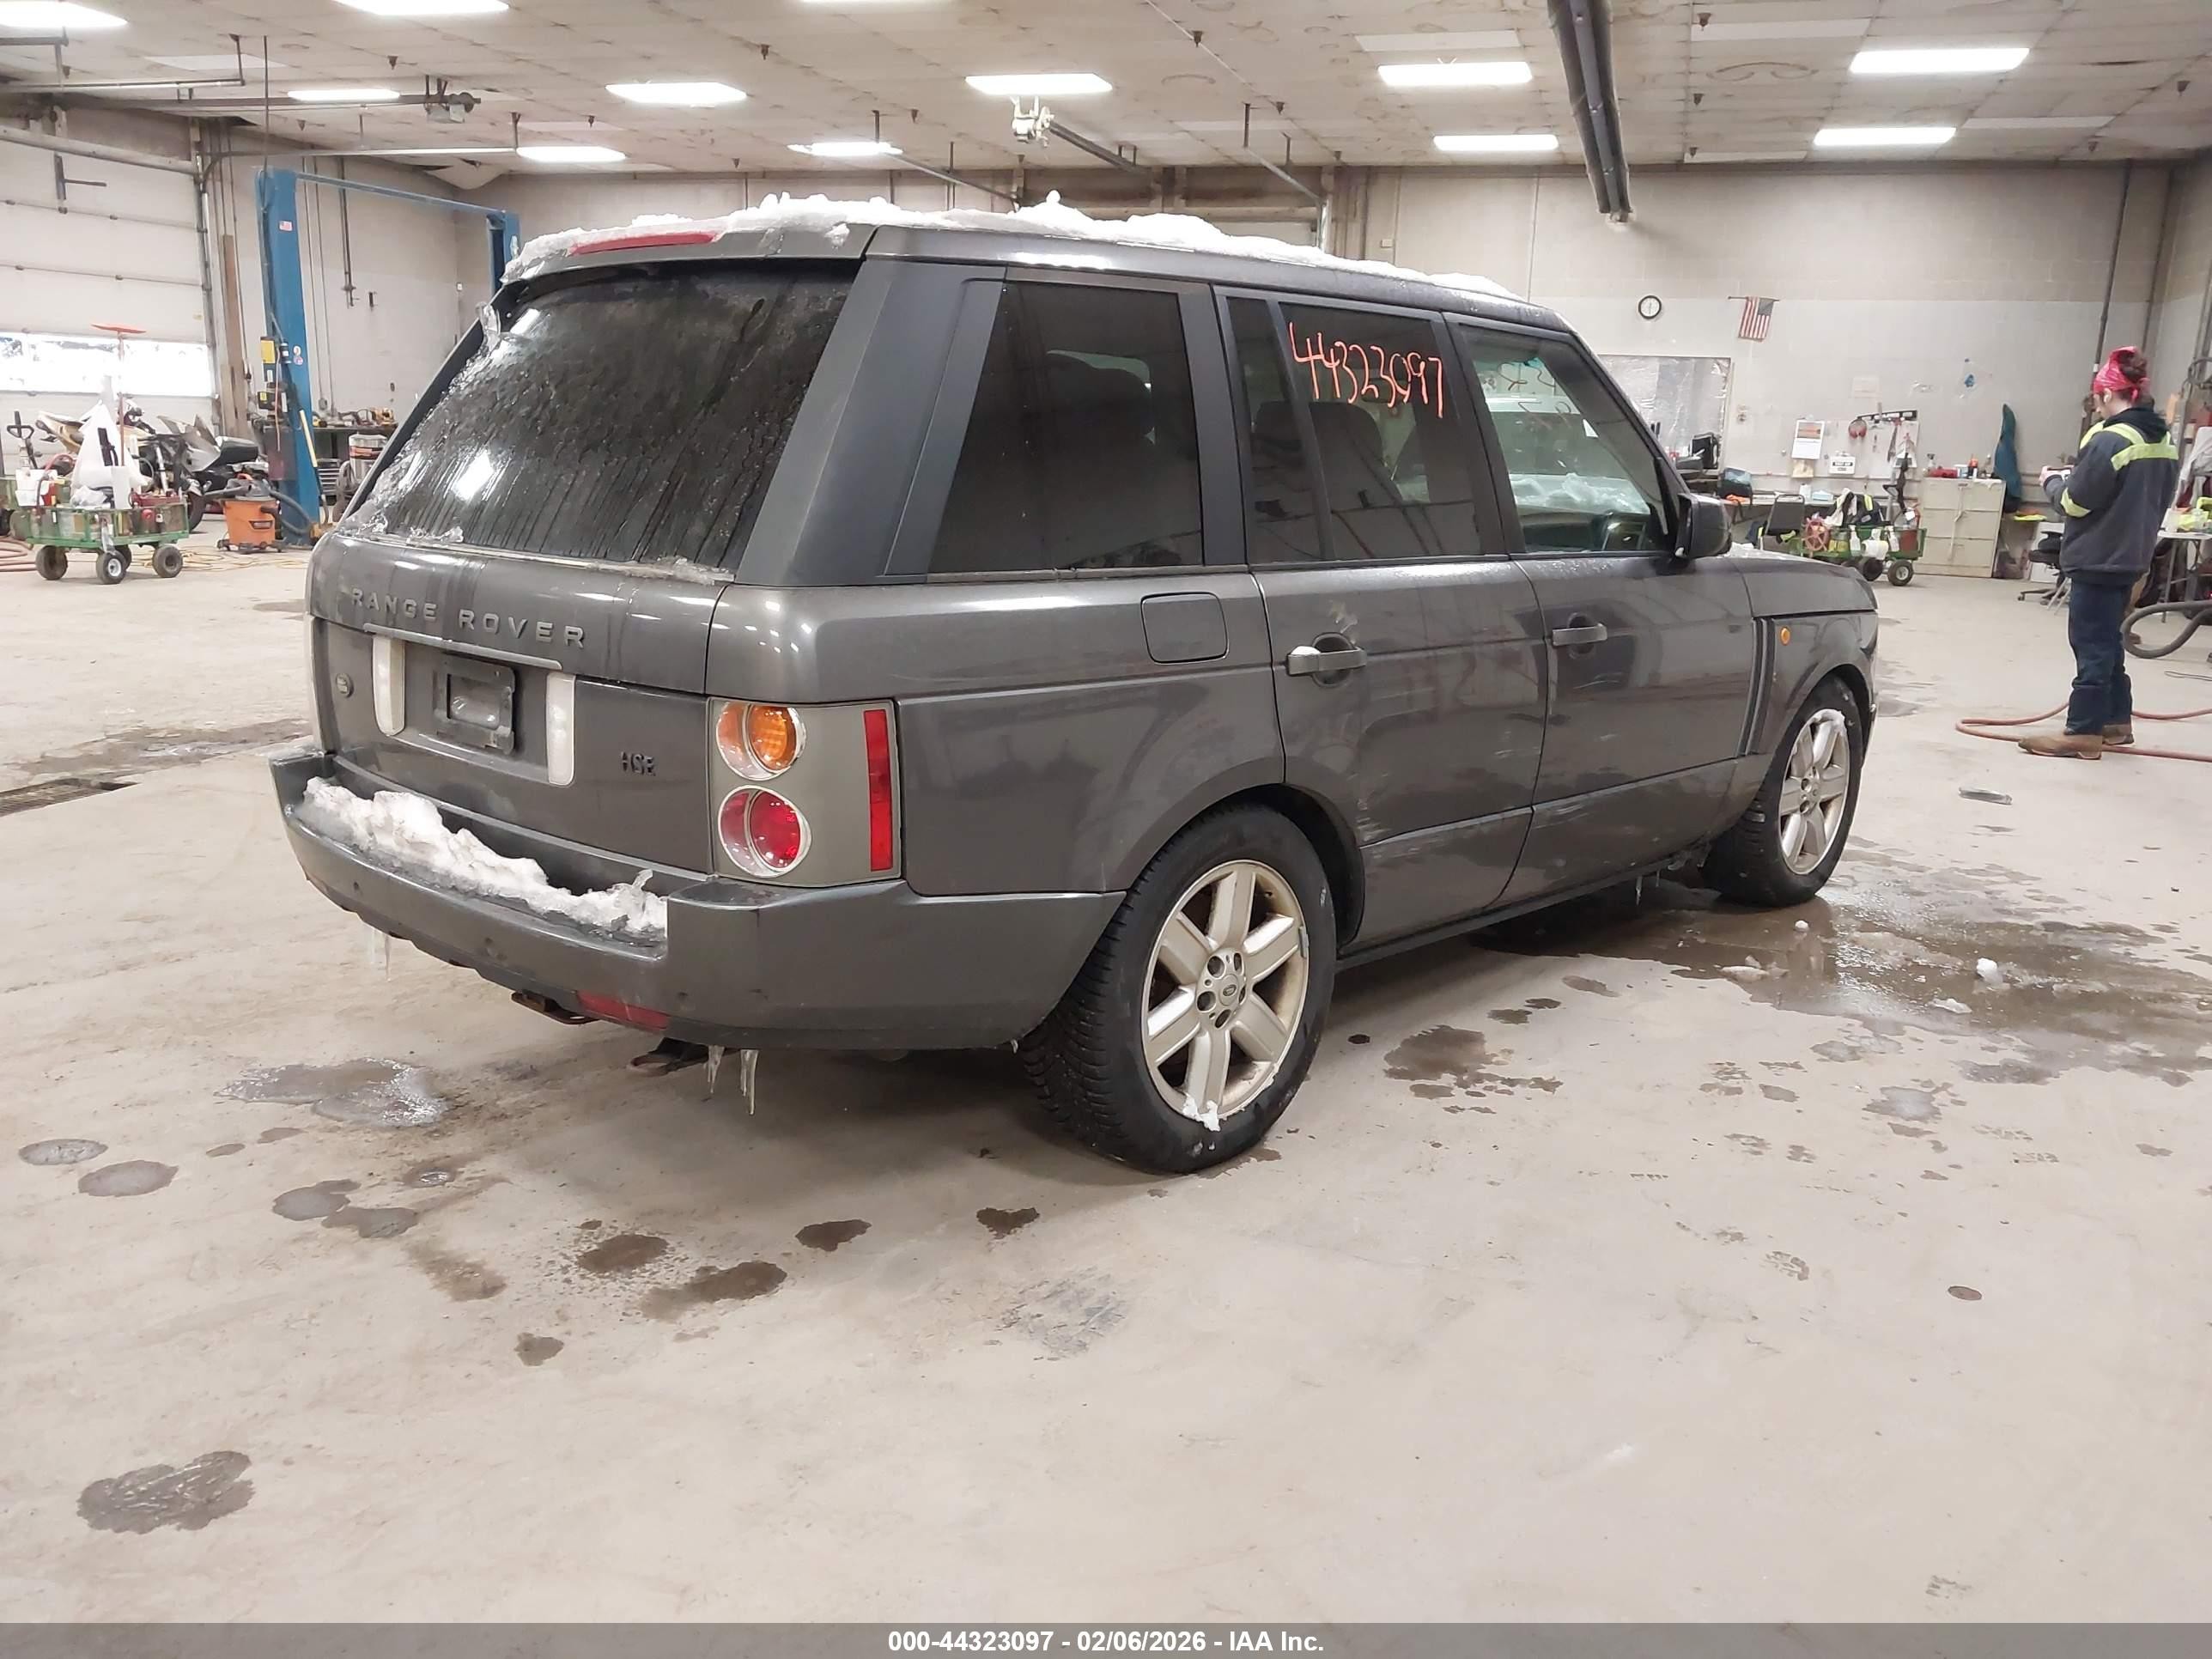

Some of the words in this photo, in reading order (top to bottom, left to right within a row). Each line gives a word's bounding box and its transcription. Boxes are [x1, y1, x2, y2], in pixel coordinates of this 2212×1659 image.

[1289, 321, 1443, 419] 44323097
[351, 586, 438, 622] RANGE
[458, 608, 585, 648] ROVER
